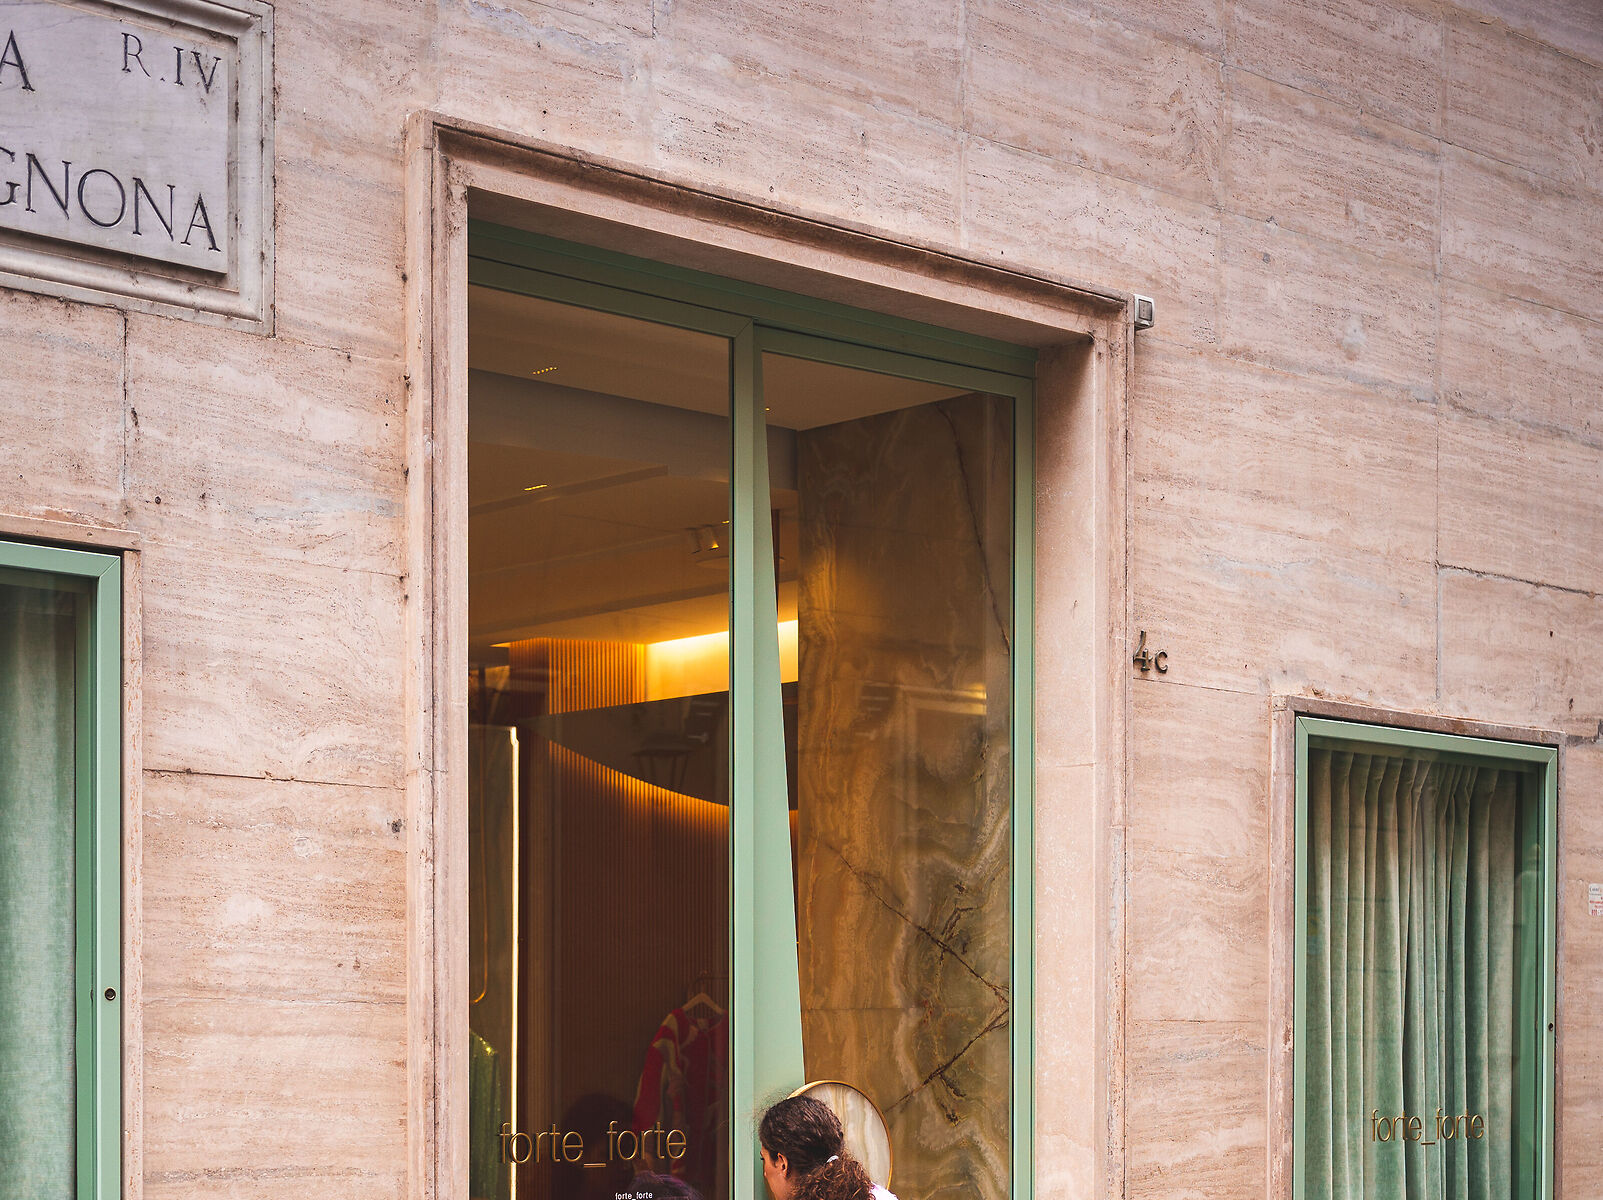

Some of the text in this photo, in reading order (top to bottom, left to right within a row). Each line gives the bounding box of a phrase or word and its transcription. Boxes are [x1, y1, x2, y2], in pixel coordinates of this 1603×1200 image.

[499, 1120, 687, 1168] forte_forte
[1371, 1108, 1485, 1146] forte_forte
[614, 1192, 653, 1200] forte_forte
